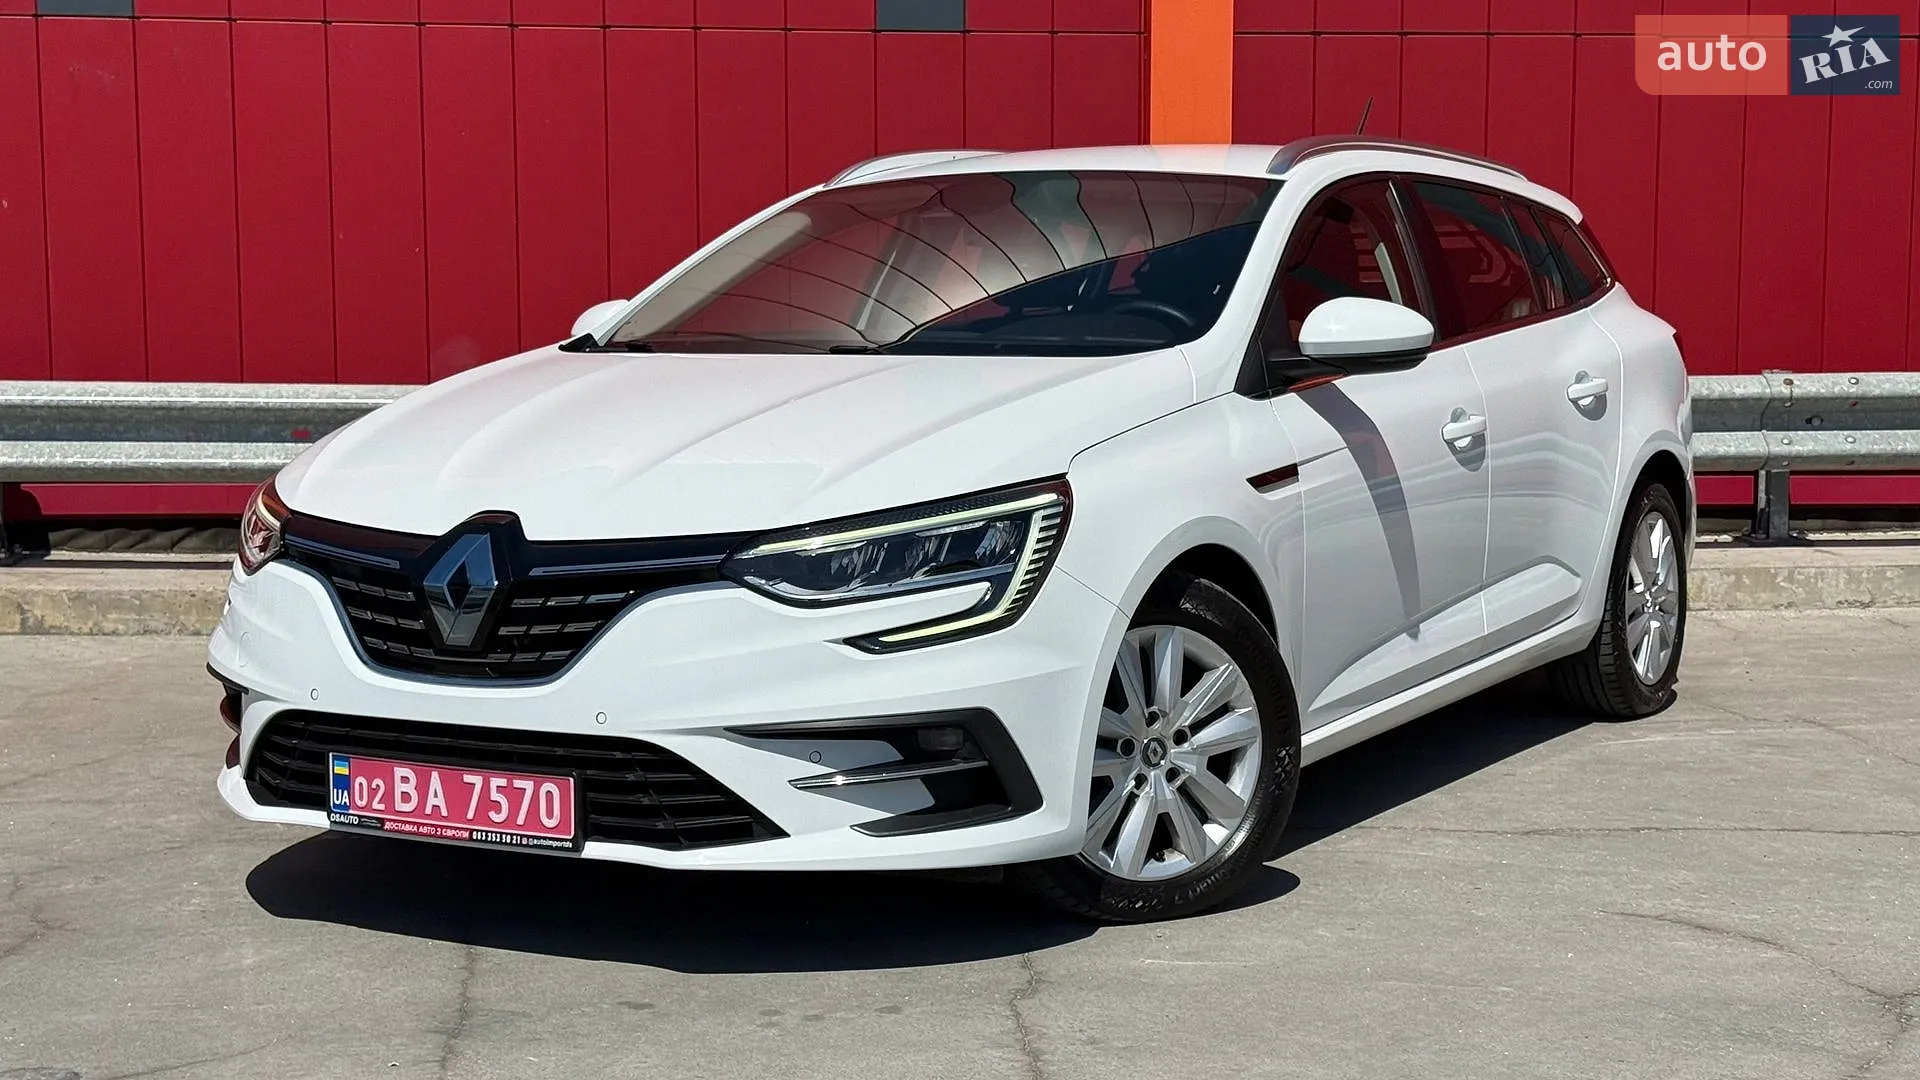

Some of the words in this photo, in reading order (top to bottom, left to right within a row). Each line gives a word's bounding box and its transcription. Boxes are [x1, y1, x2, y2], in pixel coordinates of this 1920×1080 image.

[333, 788, 350, 806] UA
[353, 775, 386, 811] 02
[393, 766, 449, 817] BA
[463, 773, 561, 829] 7570
